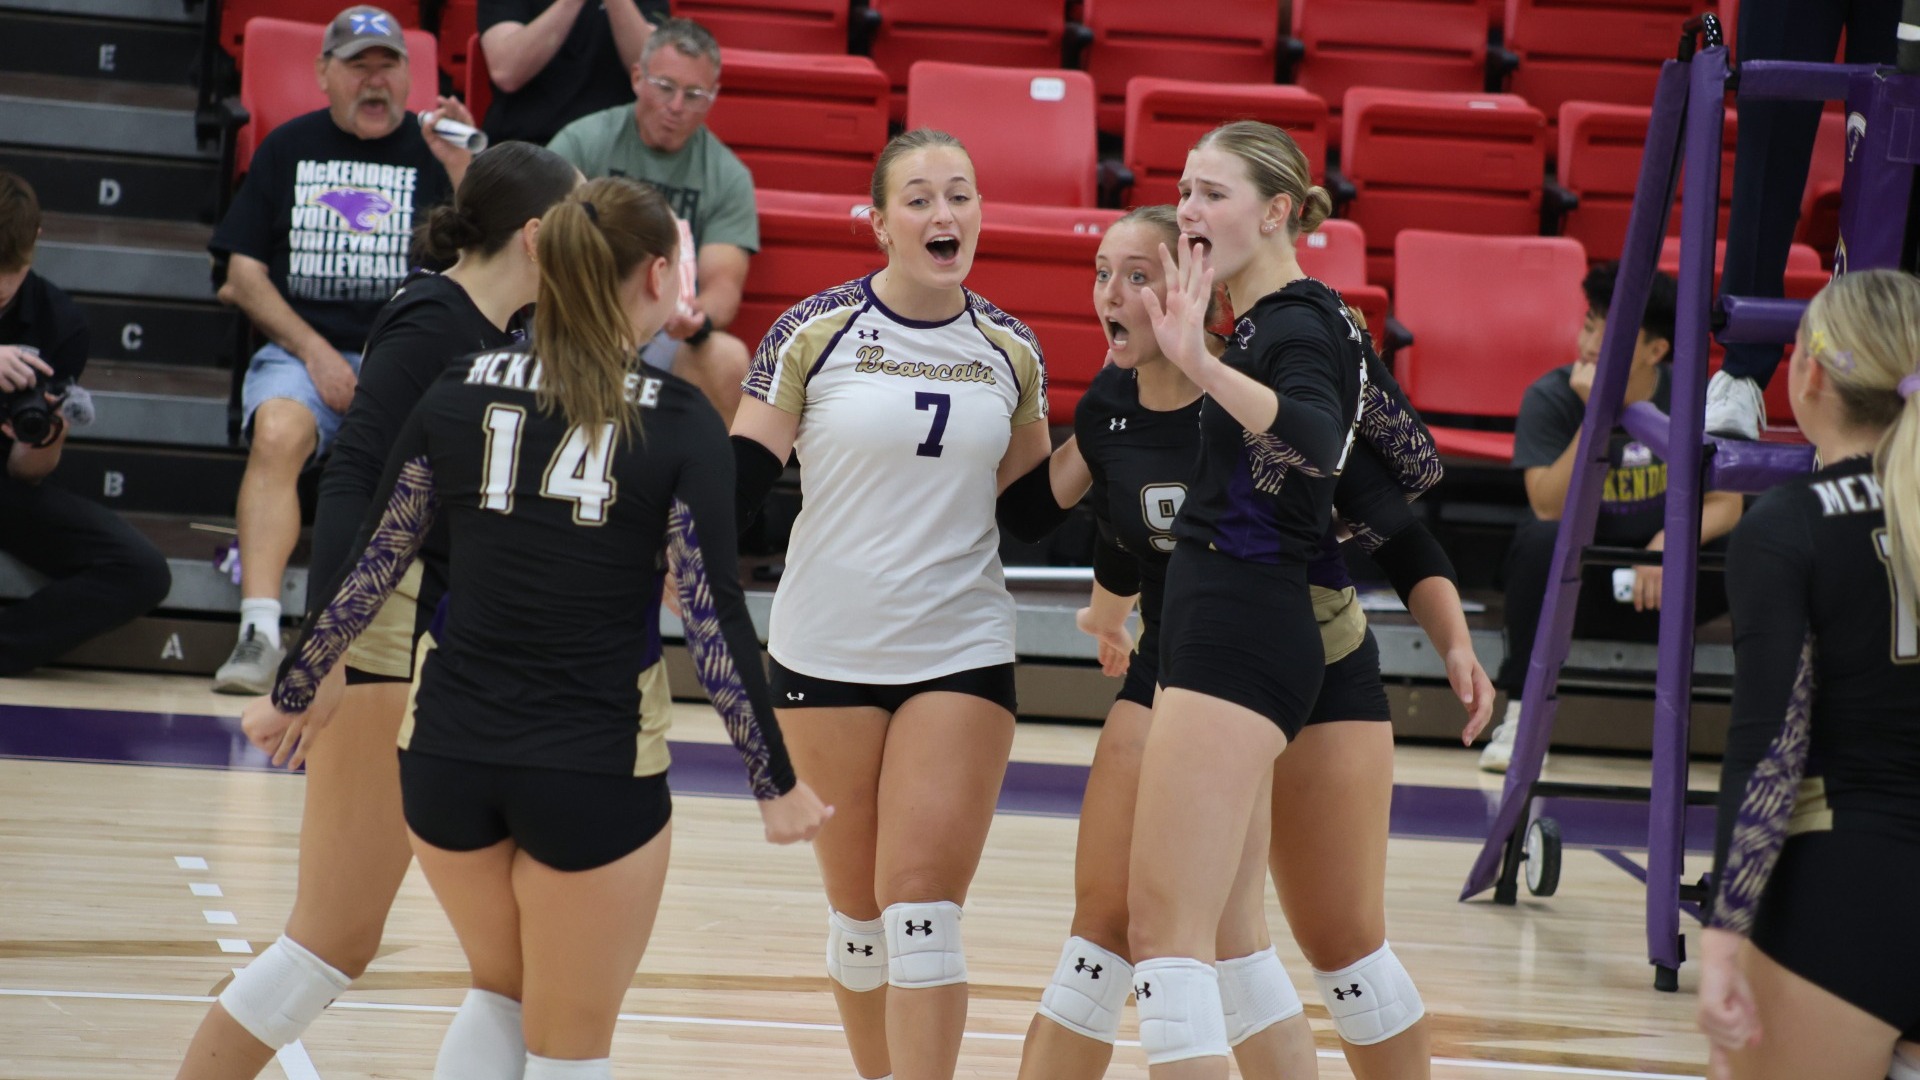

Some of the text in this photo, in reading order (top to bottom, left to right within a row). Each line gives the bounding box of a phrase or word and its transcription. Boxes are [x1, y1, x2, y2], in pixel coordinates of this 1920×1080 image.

[98, 44, 116, 70] E
[296, 160, 418, 191] McKENDREE
[99, 178, 121, 205] D
[289, 251, 409, 278] VOLLEYBALL
[122, 323, 143, 350] C
[855, 345, 997, 385] Bearcats
[915, 391, 951, 458] 7
[479, 402, 621, 526] 14
[104, 471, 124, 497] B
[1140, 482, 1188, 552] 9
[161, 633, 184, 660] A
